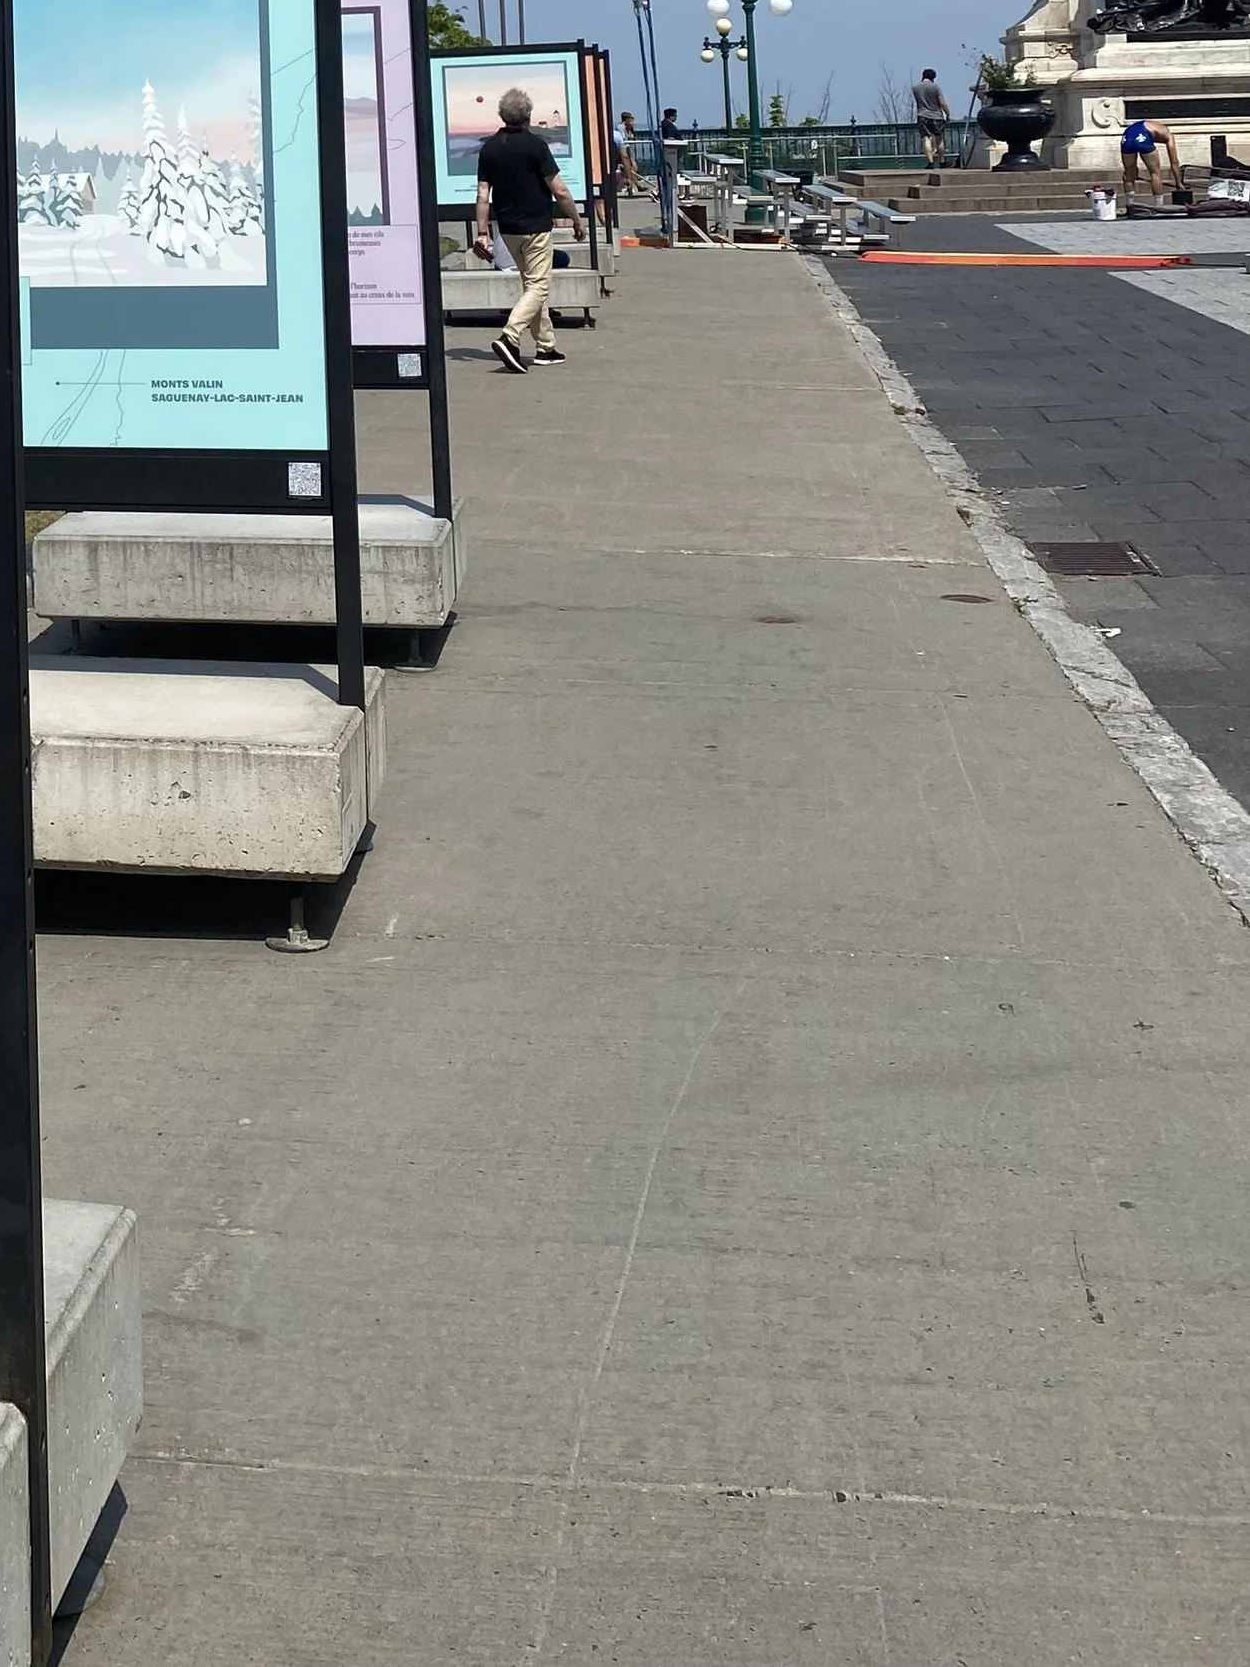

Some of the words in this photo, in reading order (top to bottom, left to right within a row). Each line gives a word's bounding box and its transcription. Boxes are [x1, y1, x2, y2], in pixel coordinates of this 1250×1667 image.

[151, 380, 189, 389] MONTS
[192, 380, 223, 389] VALIN
[151, 393, 303, 403] SAGUENAY-LAC-SAINT-JEAN
